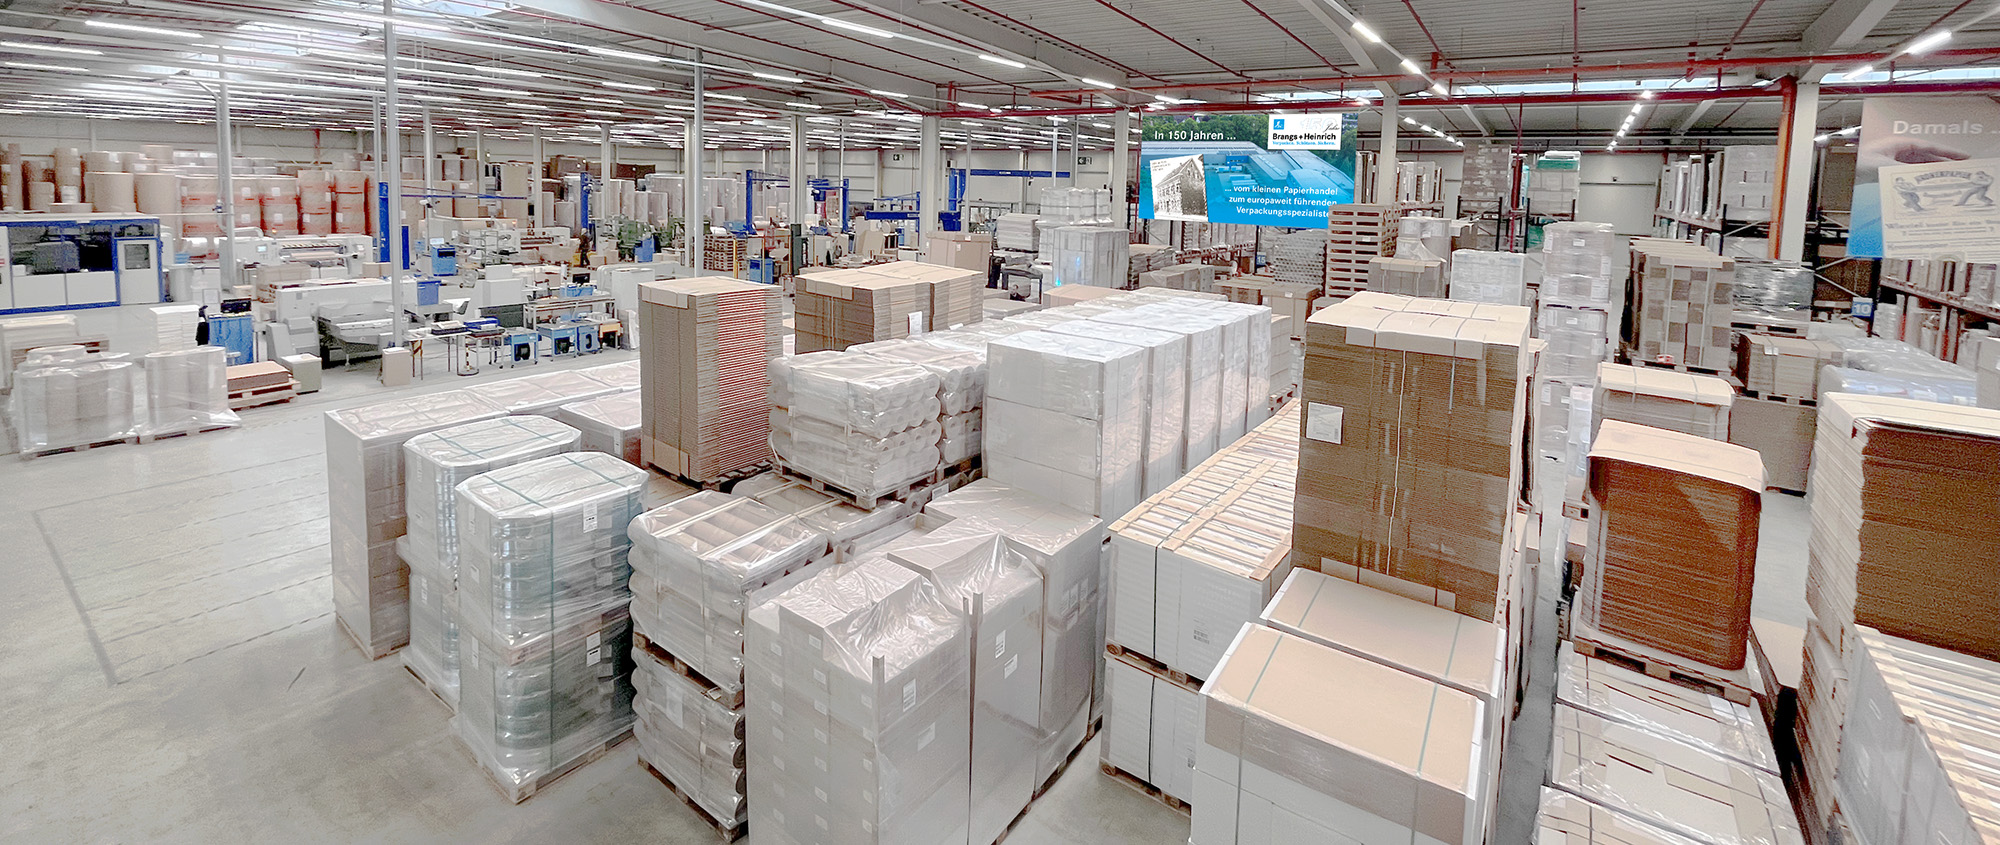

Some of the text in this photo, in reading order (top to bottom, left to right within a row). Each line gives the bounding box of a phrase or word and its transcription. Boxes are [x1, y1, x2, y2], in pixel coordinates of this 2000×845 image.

[1893, 120, 1983, 134] Damals
[1154, 130, 1164, 140] In
[1169, 130, 1187, 140] 150
[1189, 130, 1224, 142] Jahren
[1272, 133, 1298, 141] Brangs
[1252, 185, 1281, 193] kleinen
[1283, 186, 1338, 195] Papierhandel
[1247, 197, 1292, 205] europaweit
[1294, 198, 1337, 206] führenden
[1257, 256, 1266, 264] 15
